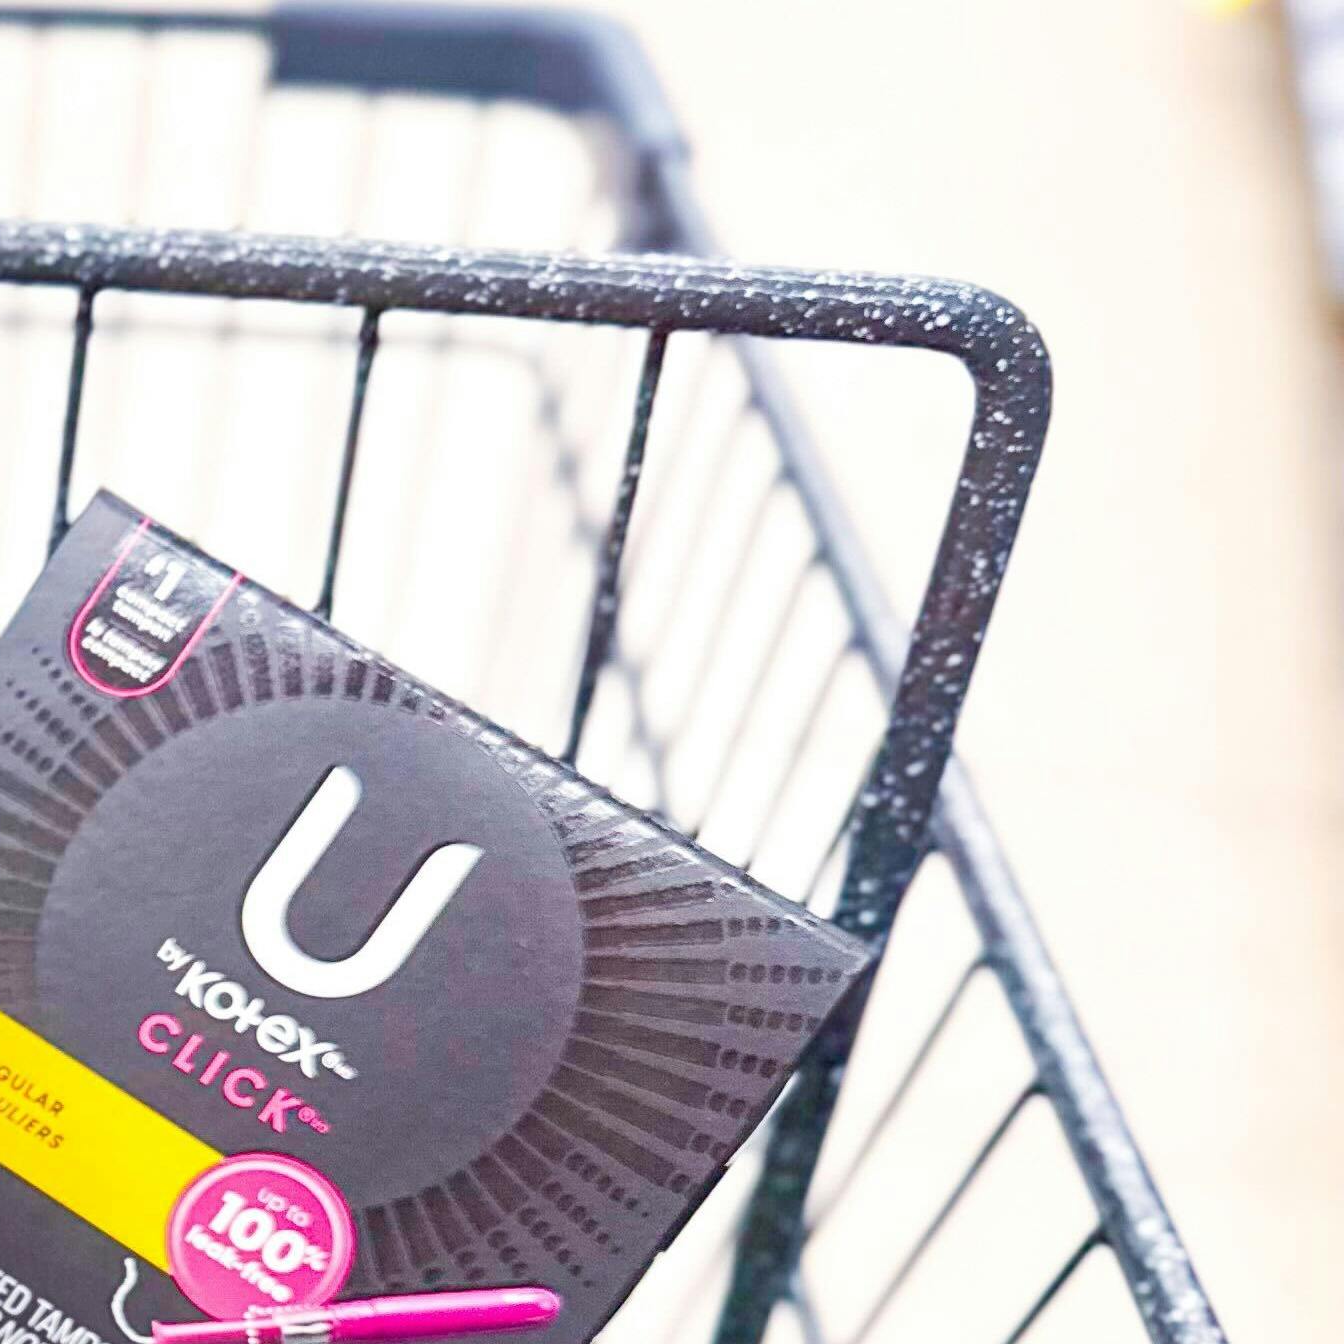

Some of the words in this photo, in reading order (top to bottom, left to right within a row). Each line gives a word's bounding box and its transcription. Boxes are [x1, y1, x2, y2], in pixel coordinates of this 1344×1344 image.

[242, 765, 487, 999] U
[157, 937, 193, 972] by
[138, 1012, 304, 1134] CLICK
[208, 1190, 330, 1274] 100%
